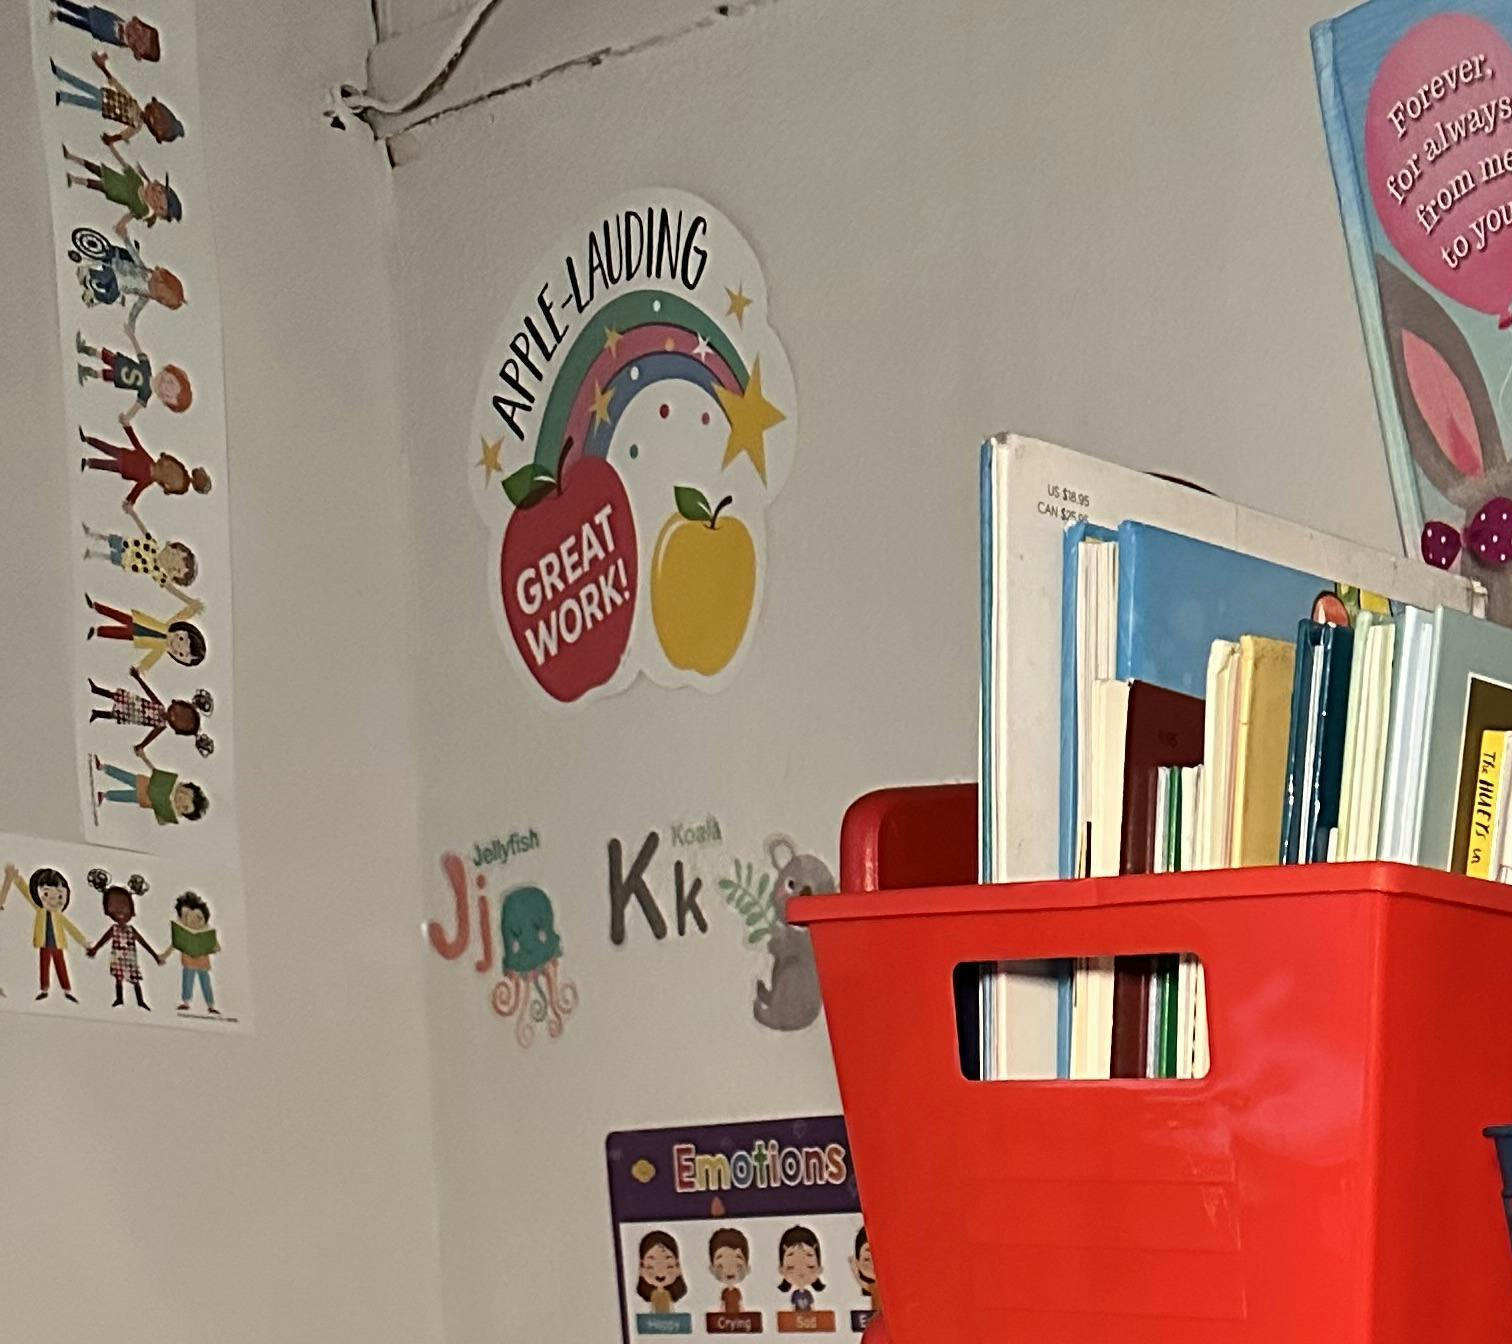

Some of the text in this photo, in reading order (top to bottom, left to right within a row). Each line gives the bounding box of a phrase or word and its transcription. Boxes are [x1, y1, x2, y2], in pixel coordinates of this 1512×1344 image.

[1386, 54, 1495, 138] Forever,
[1386, 153, 1423, 205] for
[1416, 169, 1475, 235] from
[1441, 235, 1469, 269] to
[492, 206, 708, 441] APPLE-LAUDING
[1037, 501, 1058, 518] CAN
[1047, 484, 1060, 498] US
[517, 504, 615, 615] GREAT
[525, 558, 630, 666] WORK!
[1481, 751, 1497, 774] The
[473, 829, 540, 867] Jellyfish
[671, 814, 722, 847] Koala
[673, 1140, 847, 1193] Emotions
[716, 1316, 753, 1332] Crying
